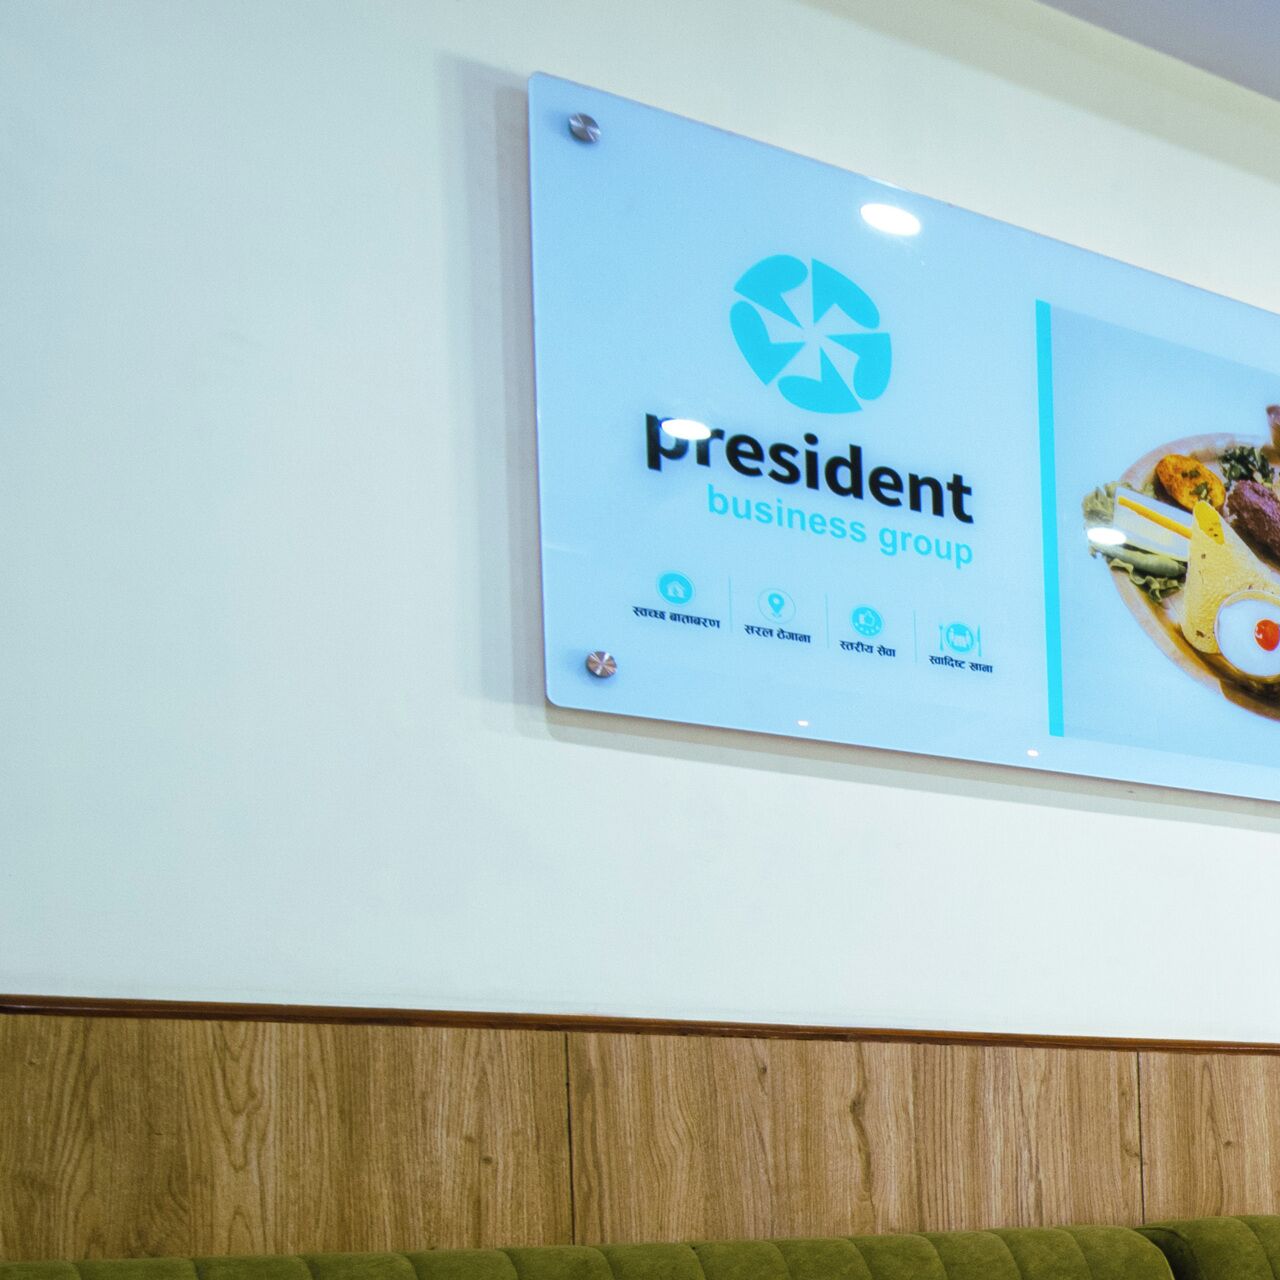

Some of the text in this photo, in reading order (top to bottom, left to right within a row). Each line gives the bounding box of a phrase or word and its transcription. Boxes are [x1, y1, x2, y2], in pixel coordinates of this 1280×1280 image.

[645, 413, 974, 524] president
[707, 483, 973, 569] business group
[744, 624, 811, 643] सरल ठेगाना
[839, 640, 874, 654] स्तरीय
[969, 661, 993, 673] खाना
